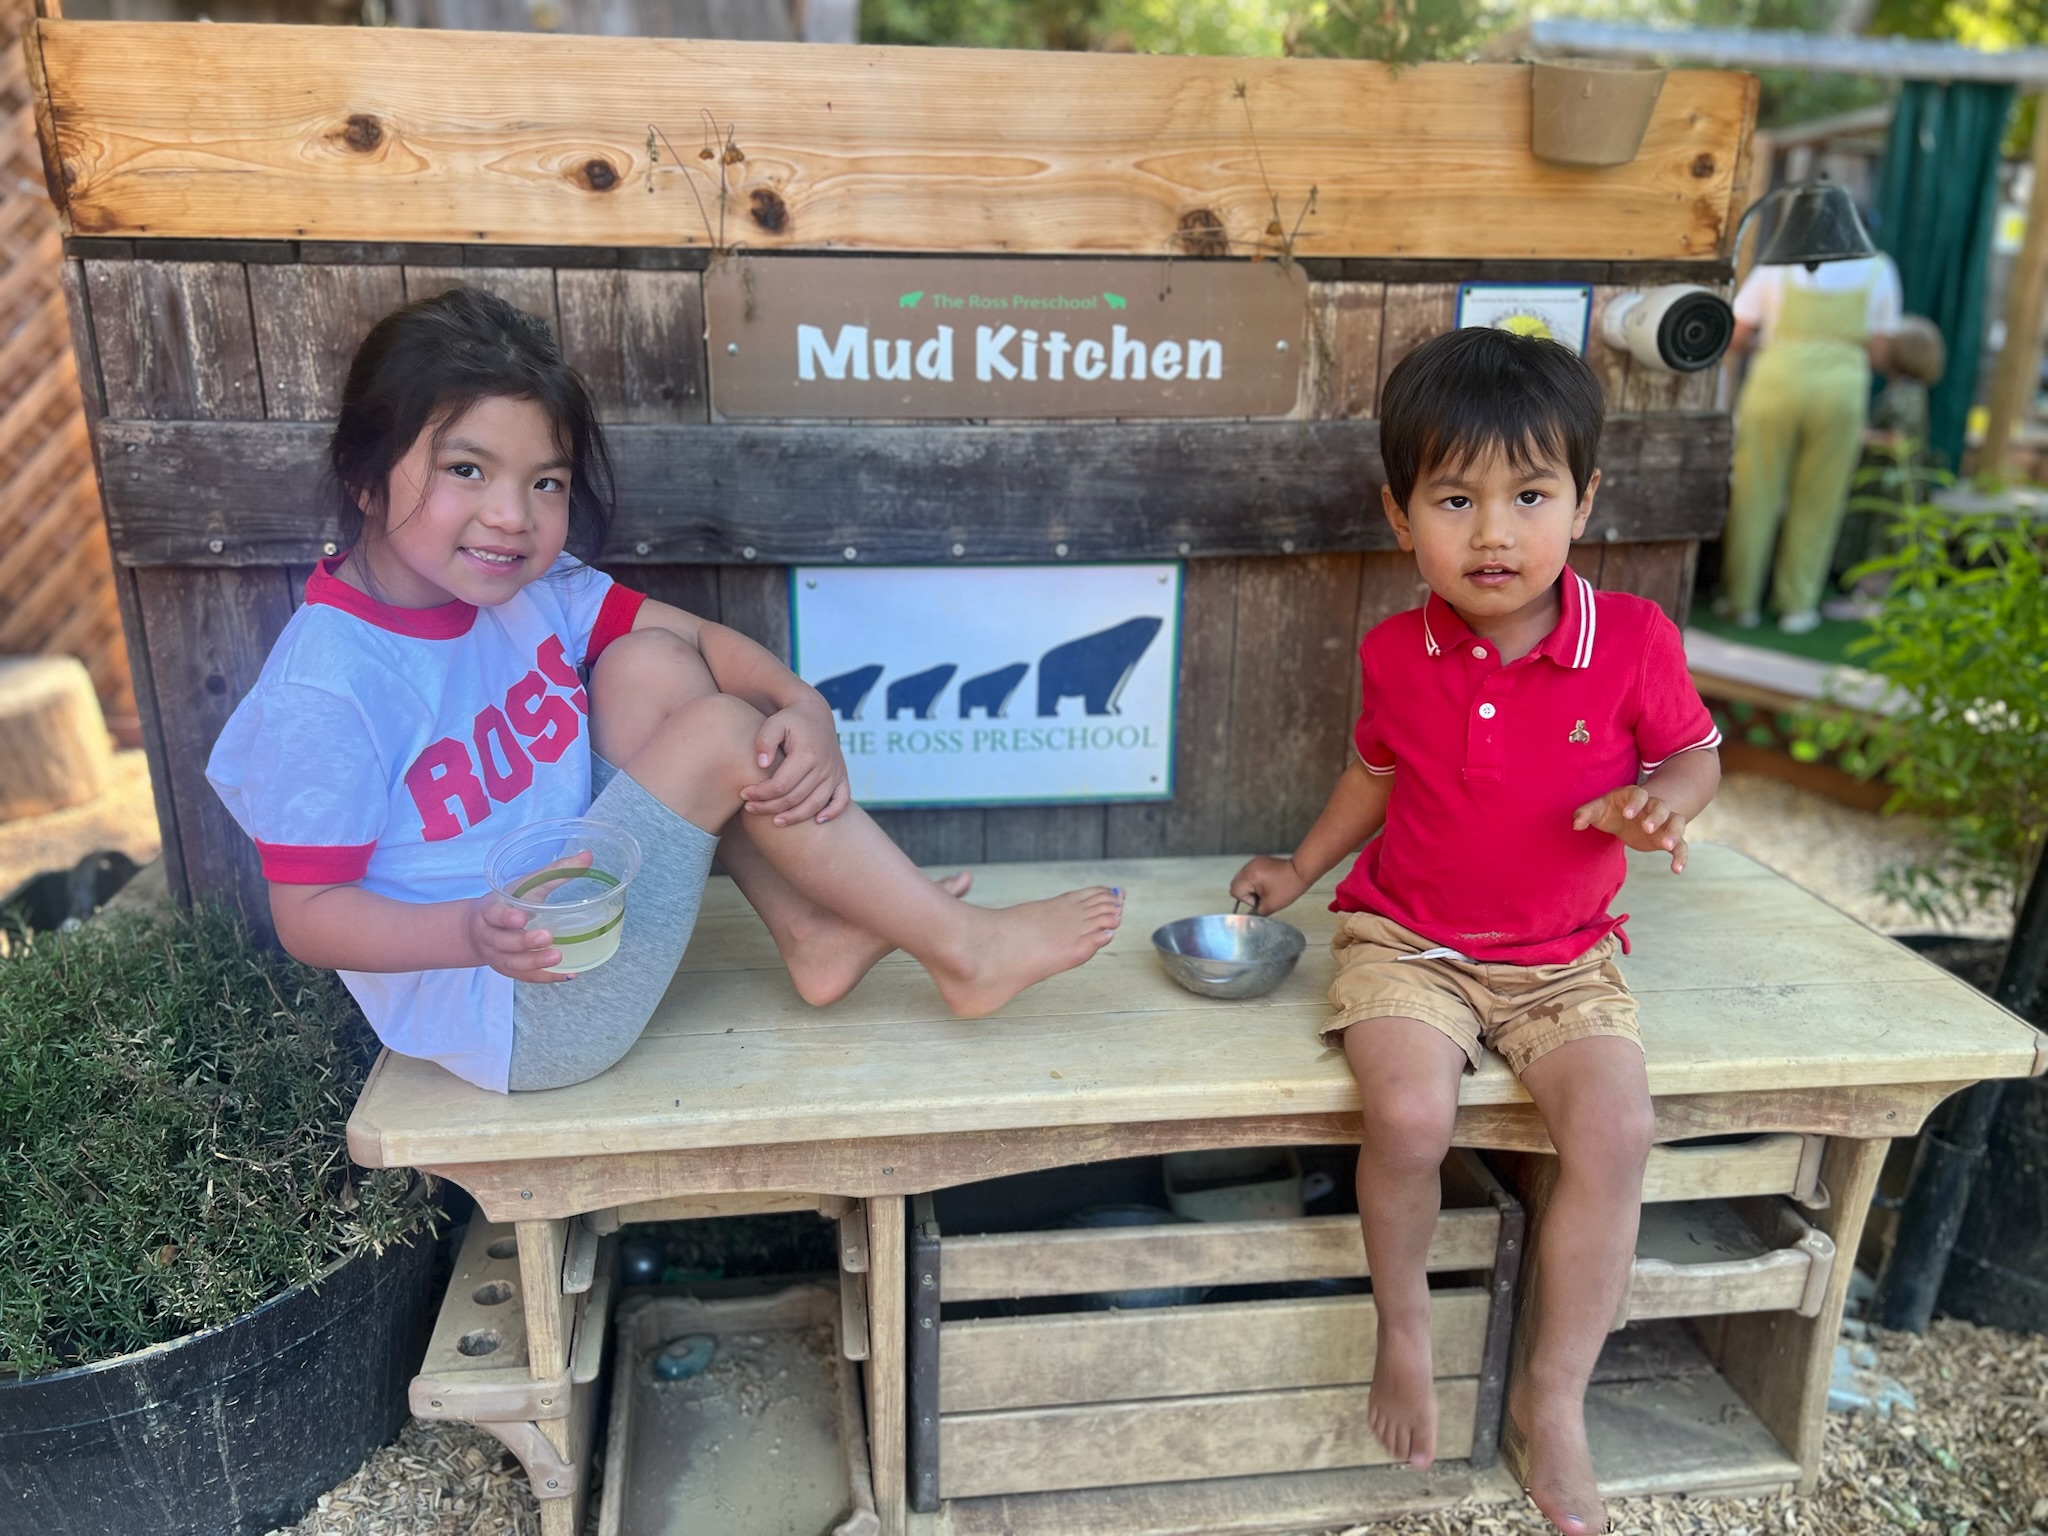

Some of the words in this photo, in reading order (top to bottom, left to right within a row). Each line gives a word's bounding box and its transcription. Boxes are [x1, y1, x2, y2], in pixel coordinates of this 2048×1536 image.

[932, 294, 963, 309] The
[968, 294, 1008, 309] Ross
[1012, 294, 1097, 310] Preschool
[797, 324, 954, 382] Mud
[975, 324, 1223, 381] Kitchen
[837, 731, 876, 755] HE
[887, 729, 962, 753] ROSS
[972, 725, 1157, 752] PRESCHOOL
